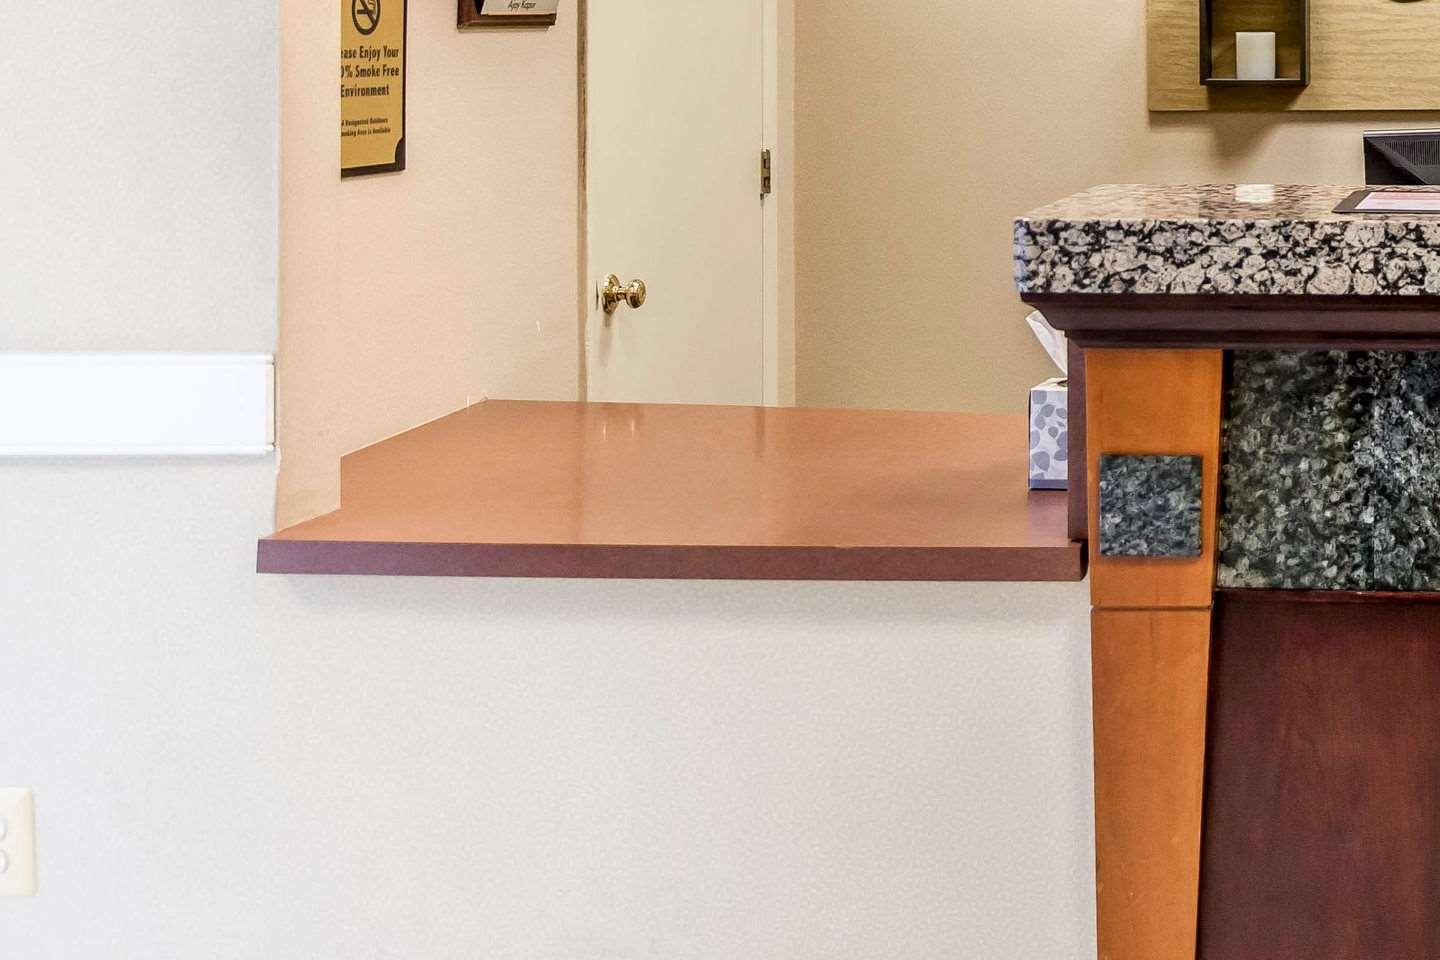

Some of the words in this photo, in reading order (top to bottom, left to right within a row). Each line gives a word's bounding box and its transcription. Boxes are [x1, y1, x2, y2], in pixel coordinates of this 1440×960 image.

[360, 45, 380, 62] Enjoy
[383, 45, 399, 58] Your
[355, 64, 380, 78] Smoke
[382, 64, 400, 76] Free
[341, 84, 390, 97] Environment
